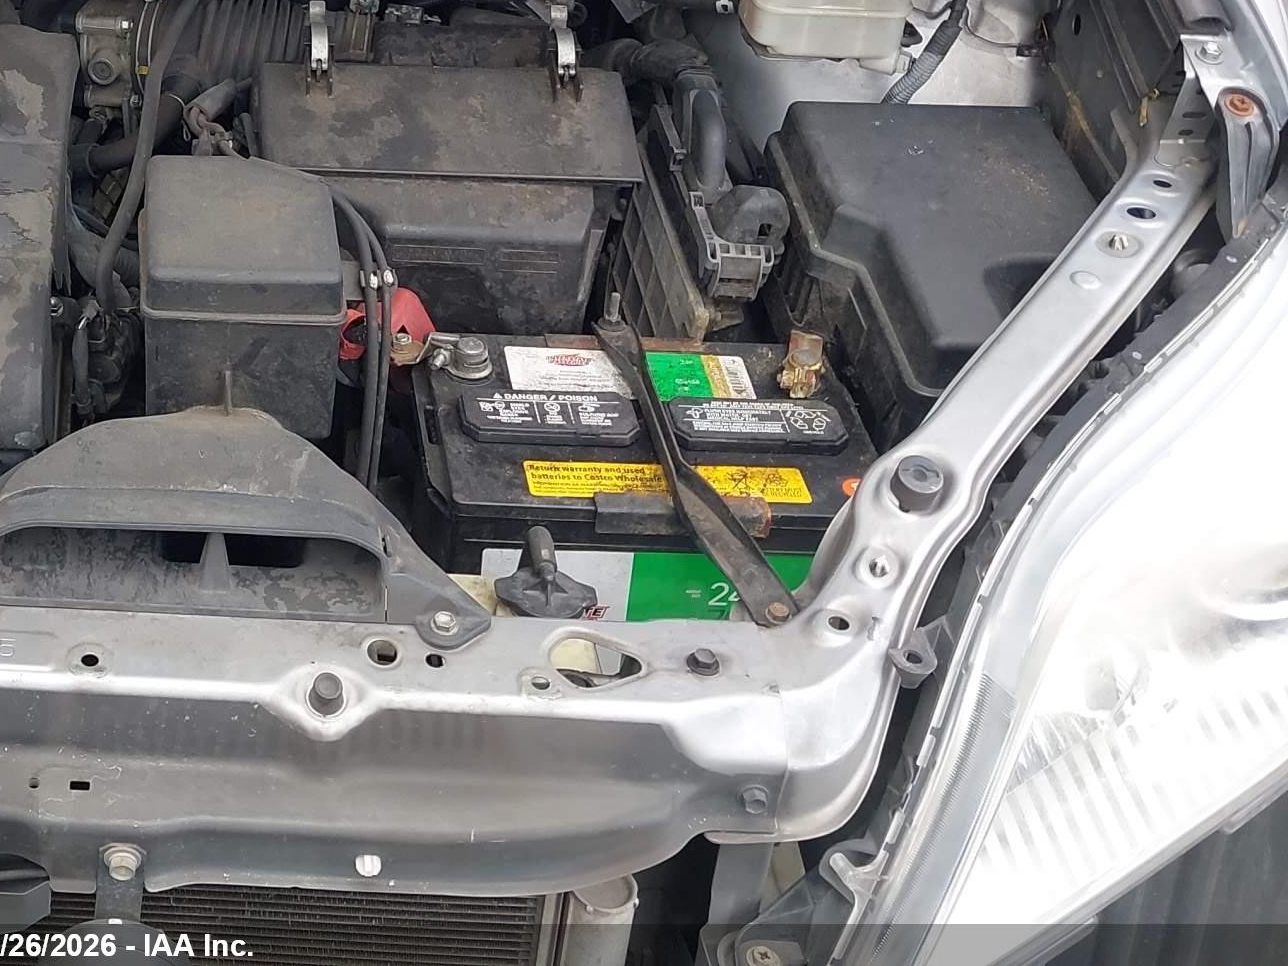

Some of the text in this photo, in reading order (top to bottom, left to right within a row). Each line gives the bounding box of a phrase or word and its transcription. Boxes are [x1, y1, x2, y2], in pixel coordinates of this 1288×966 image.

[503, 393, 548, 401] DANGER
[528, 464, 646, 474] Return warranty and used
[531, 472, 663, 482] batteries to Costco Wholesale
